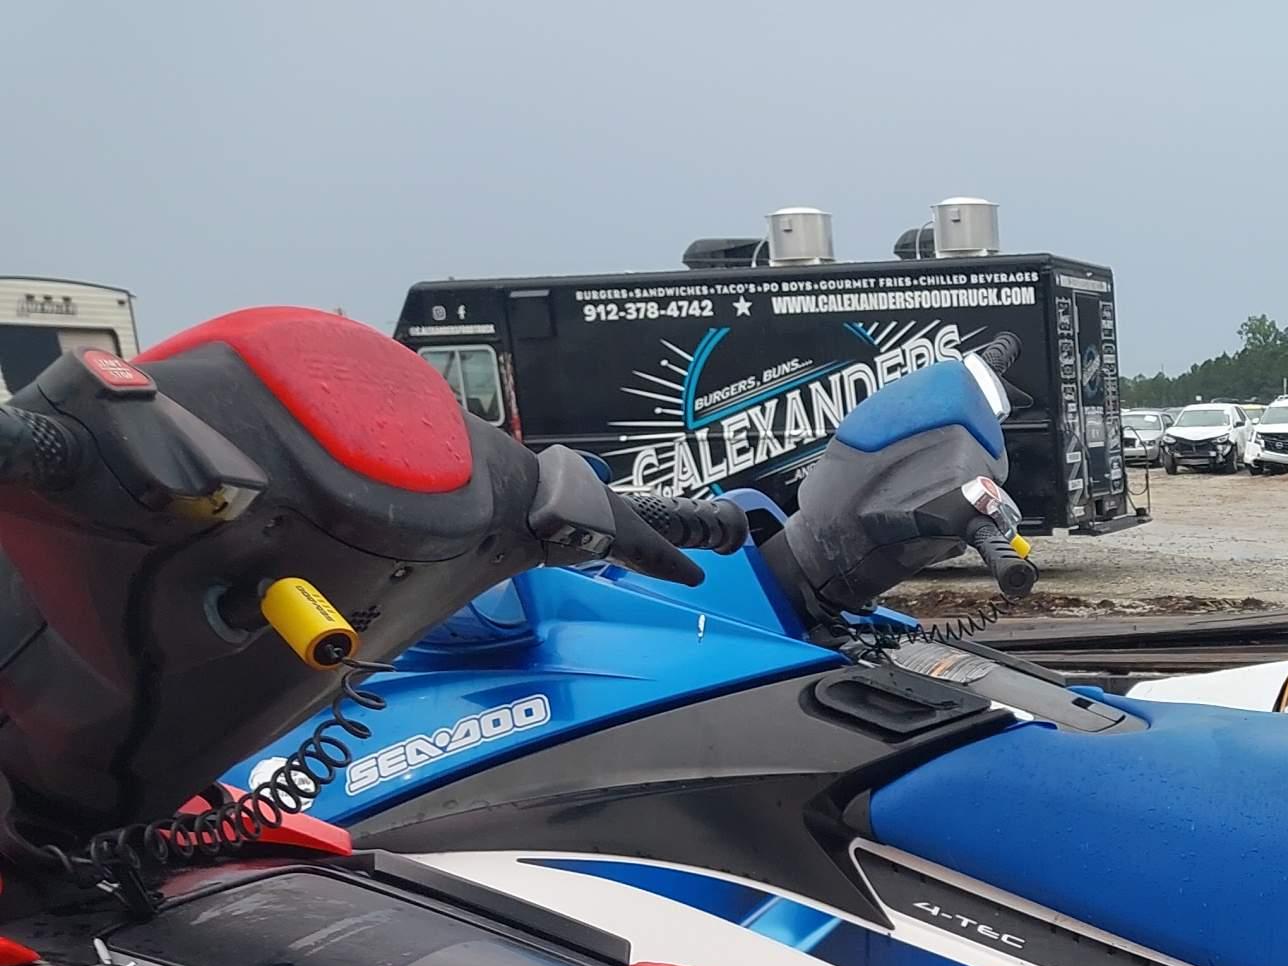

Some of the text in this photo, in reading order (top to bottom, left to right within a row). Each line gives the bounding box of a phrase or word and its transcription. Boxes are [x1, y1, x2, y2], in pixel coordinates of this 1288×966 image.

[575, 271, 1039, 301] BURGERS SANDWICHES TACO'S PO BOYS GOURMET FRIES CHILLED BEVERAGES
[771, 286, 1036, 315] WWW.CALEXANDERSFOODTRUCK.COM
[583, 299, 715, 322] 912-378-4742
[694, 375, 761, 412] BURGERS,
[912, 901, 1026, 950] 4-TEC
